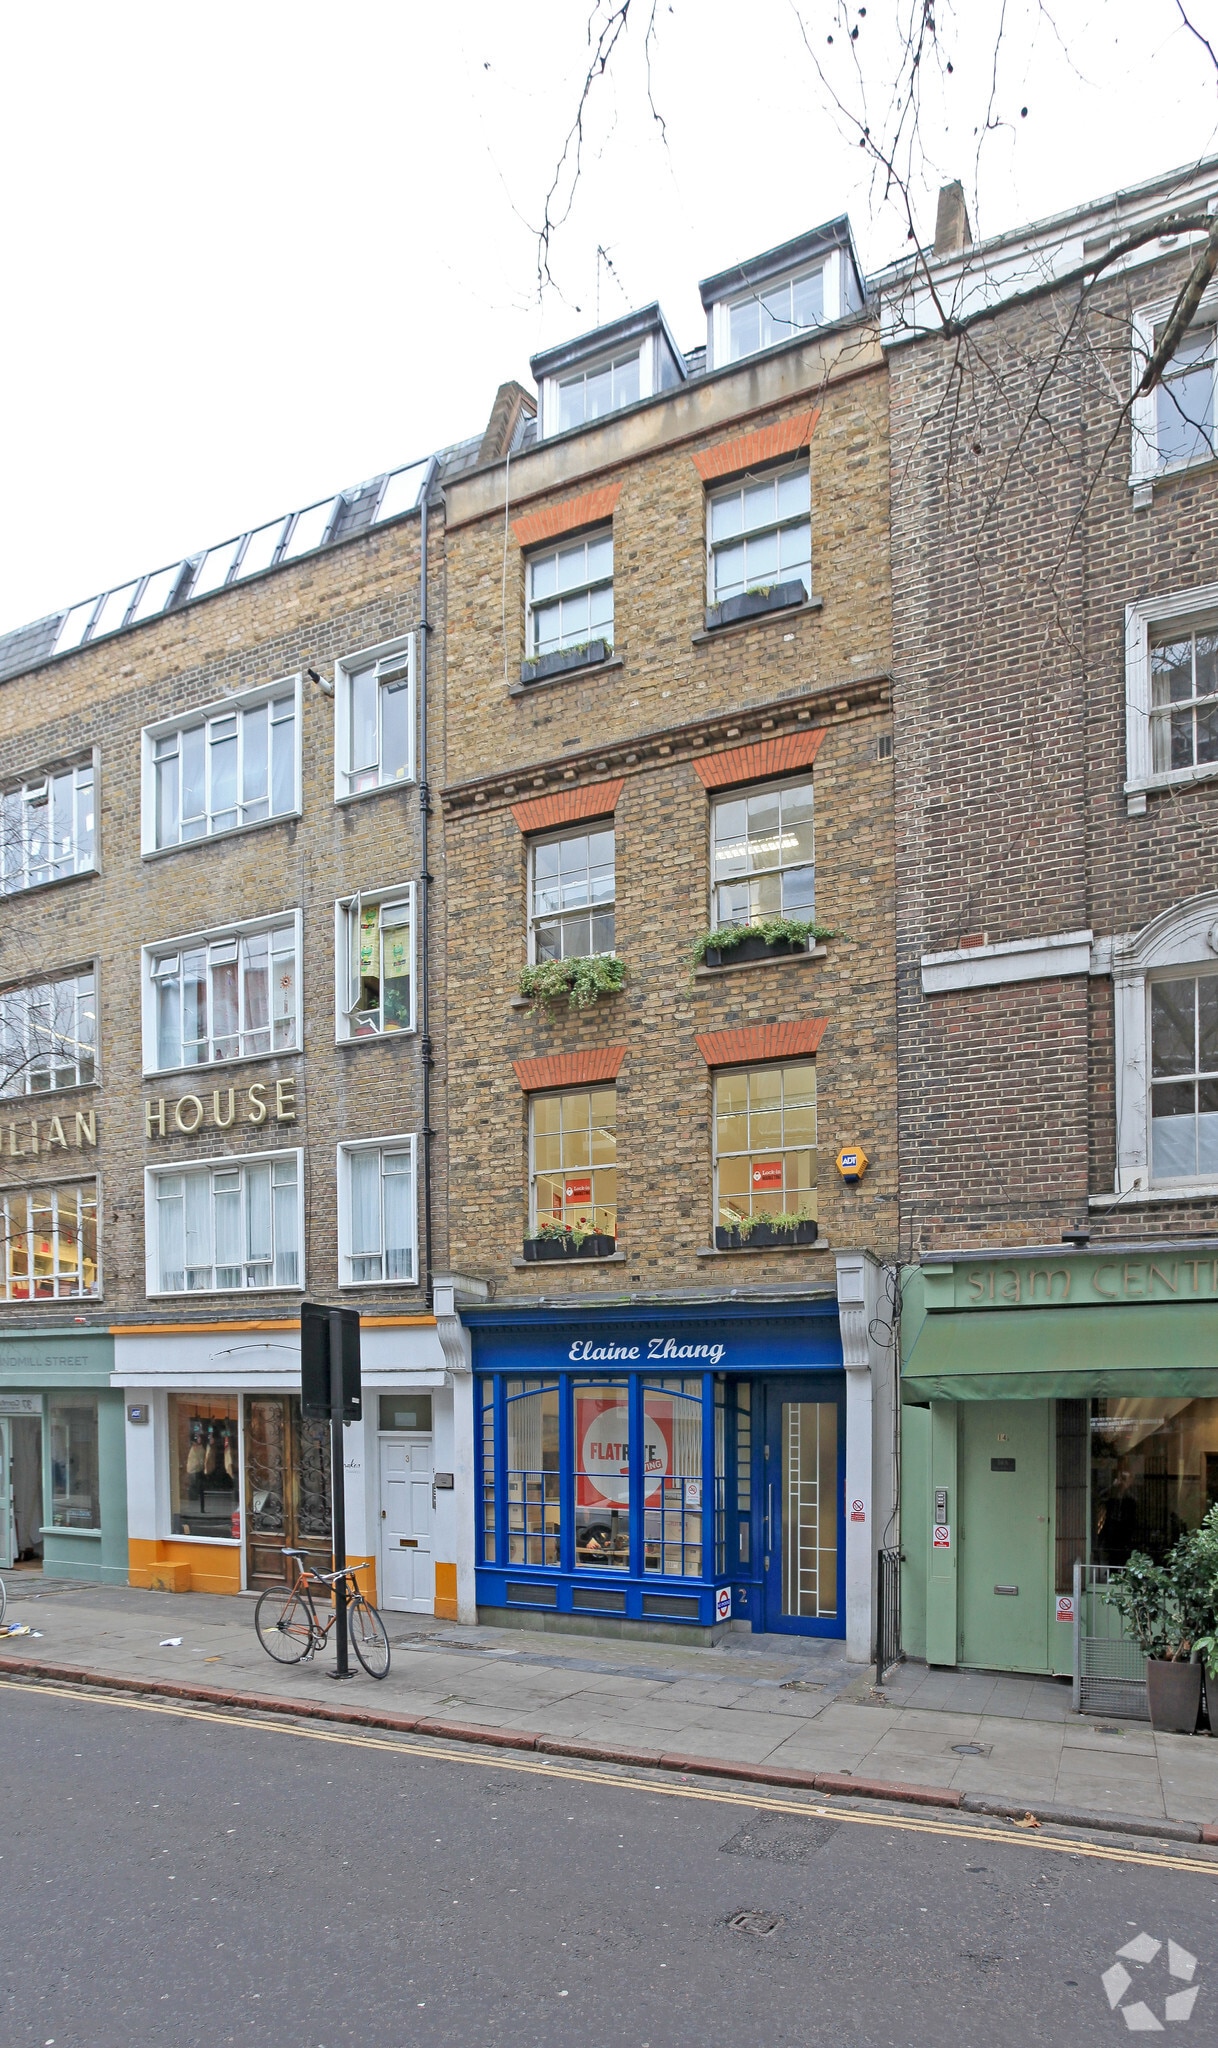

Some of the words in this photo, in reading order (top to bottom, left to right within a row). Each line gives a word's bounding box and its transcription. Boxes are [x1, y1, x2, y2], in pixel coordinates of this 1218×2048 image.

[0, 1110, 96, 1157] LIAN
[145, 1078, 296, 1139] HOUSE
[842, 1157, 856, 1165] ADT
[967, 1268, 1072, 1302] siam
[568, 1340, 641, 1361] Elaine
[647, 1337, 726, 1365] Zhang
[44, 1356, 89, 1367] STREET
[405, 1454, 410, 1463] 3
[738, 1588, 748, 1603] 2
